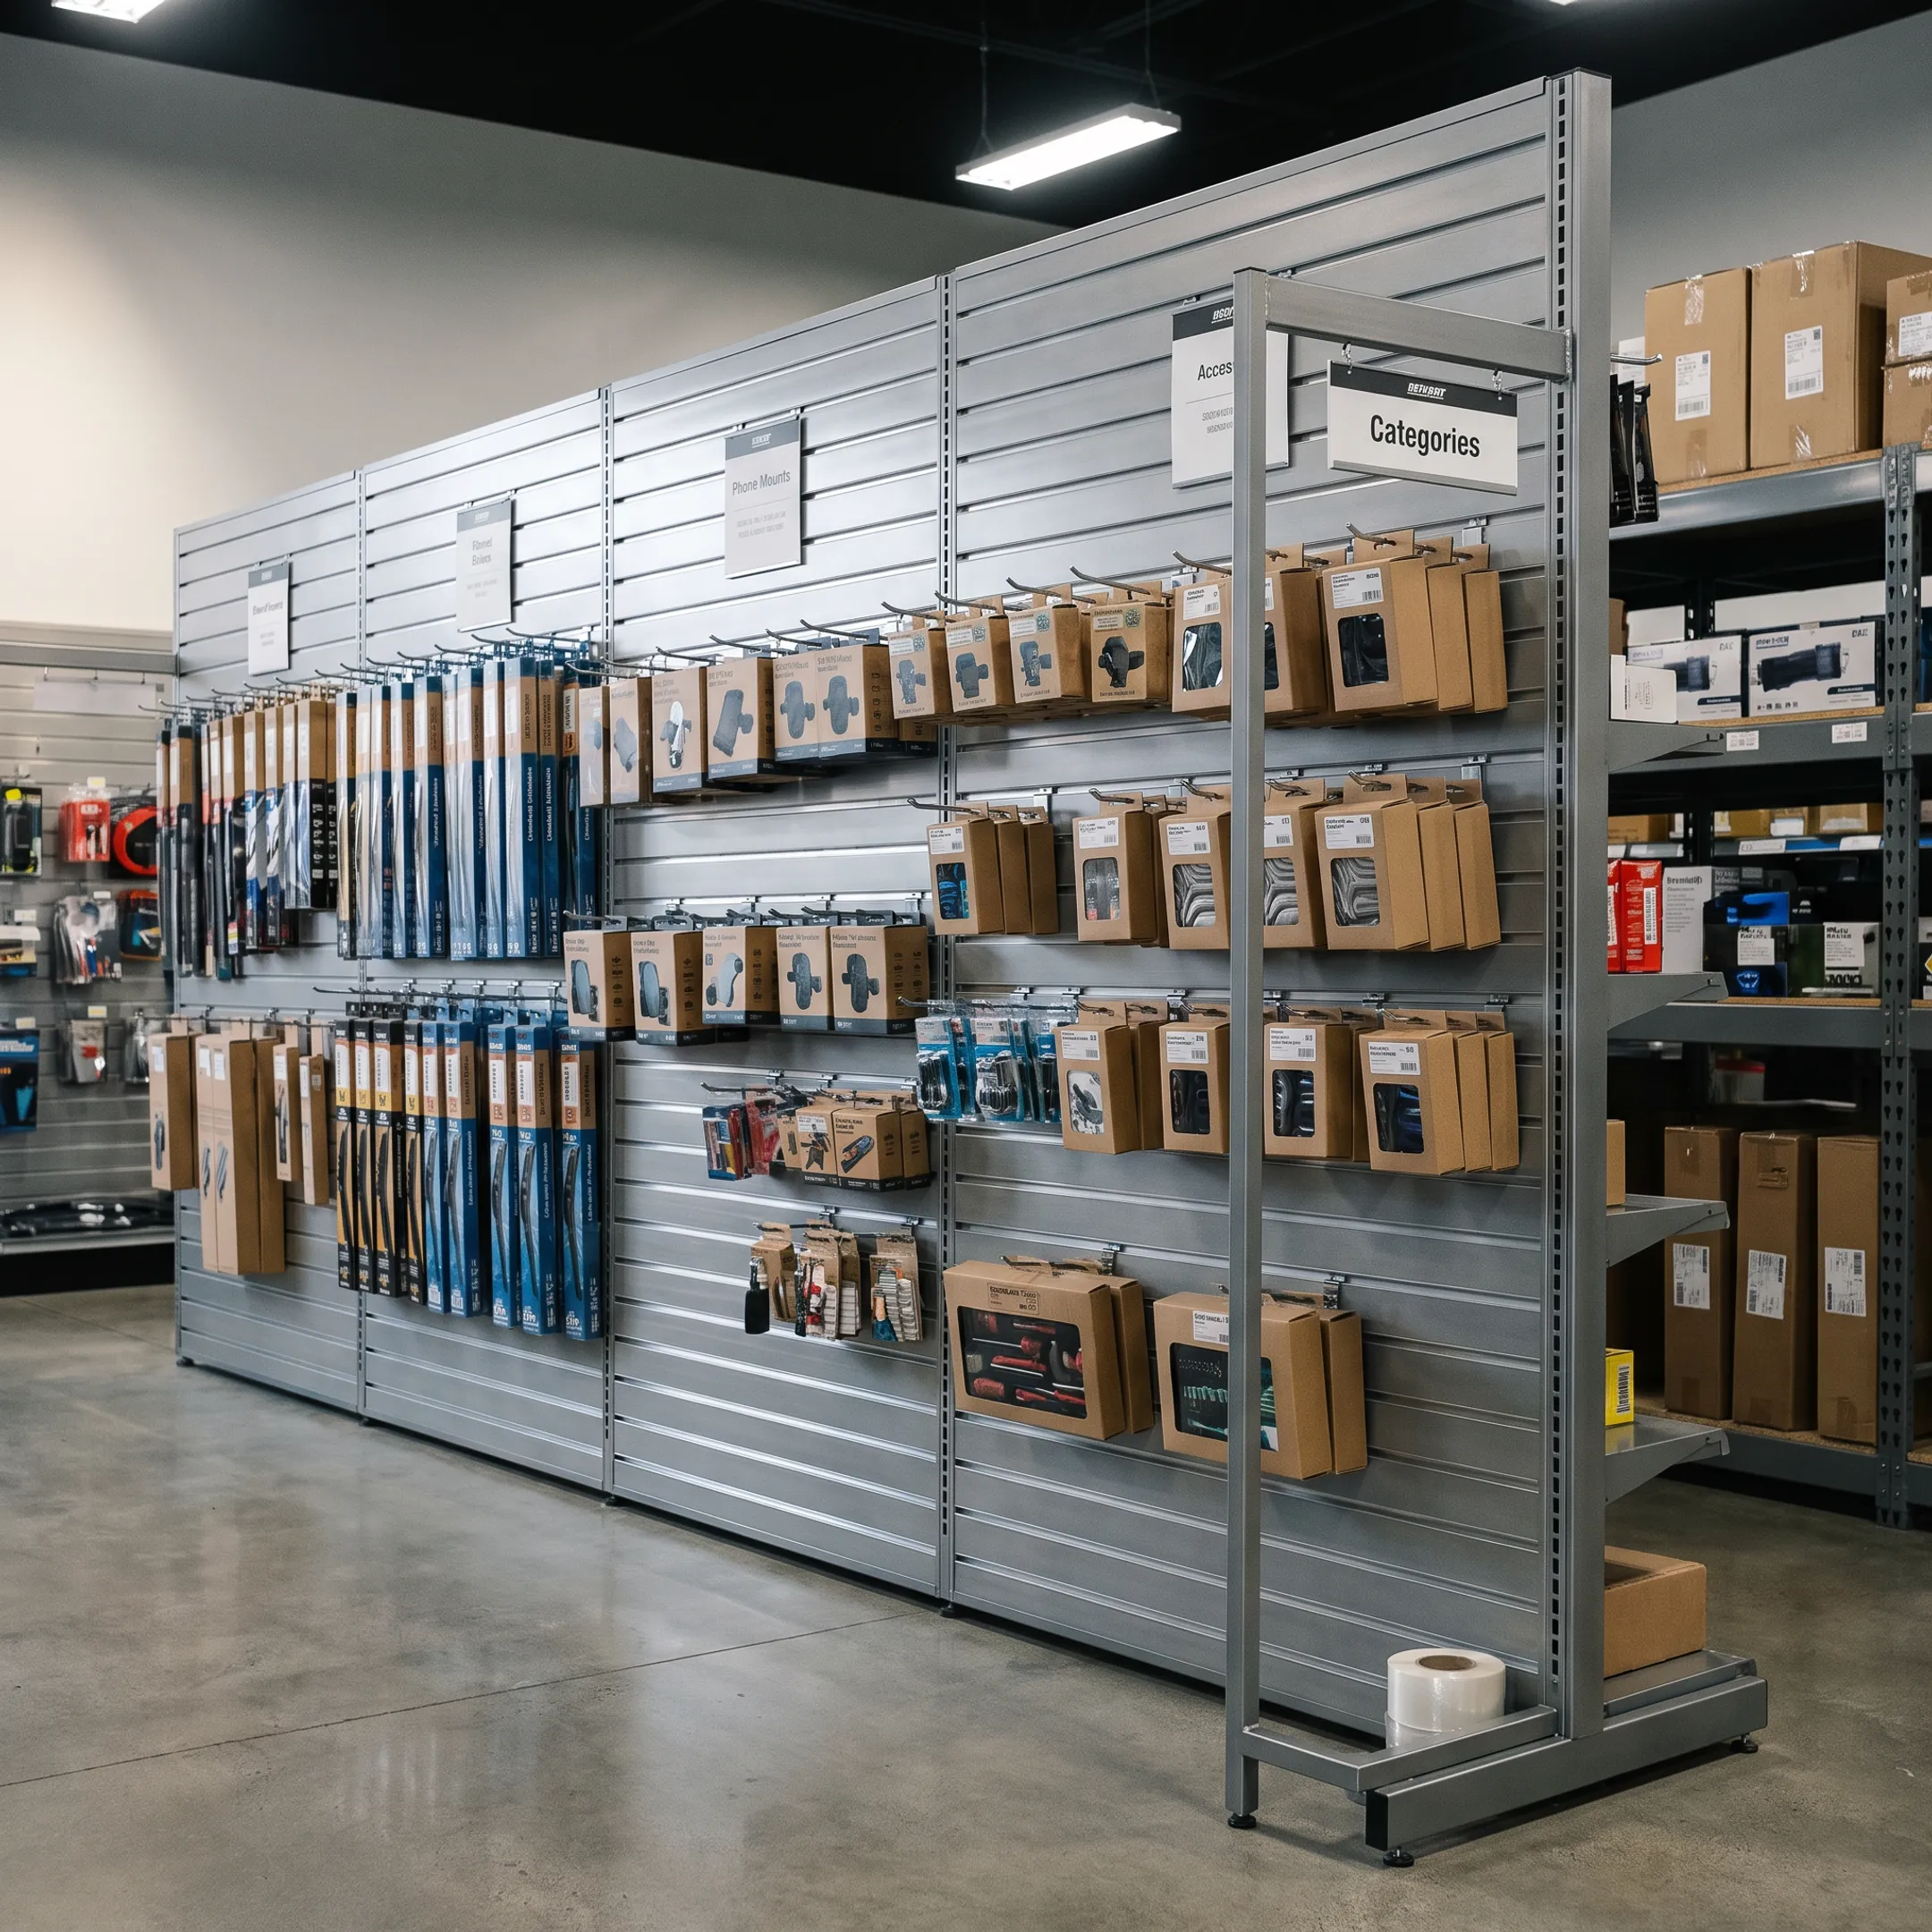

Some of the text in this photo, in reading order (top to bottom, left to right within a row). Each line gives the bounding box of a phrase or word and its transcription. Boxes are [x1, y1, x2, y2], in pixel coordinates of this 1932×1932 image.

[1198, 361, 1234, 381] Acces
[1370, 414, 1480, 458] Categories
[732, 470, 791, 496] Phone Mounts
